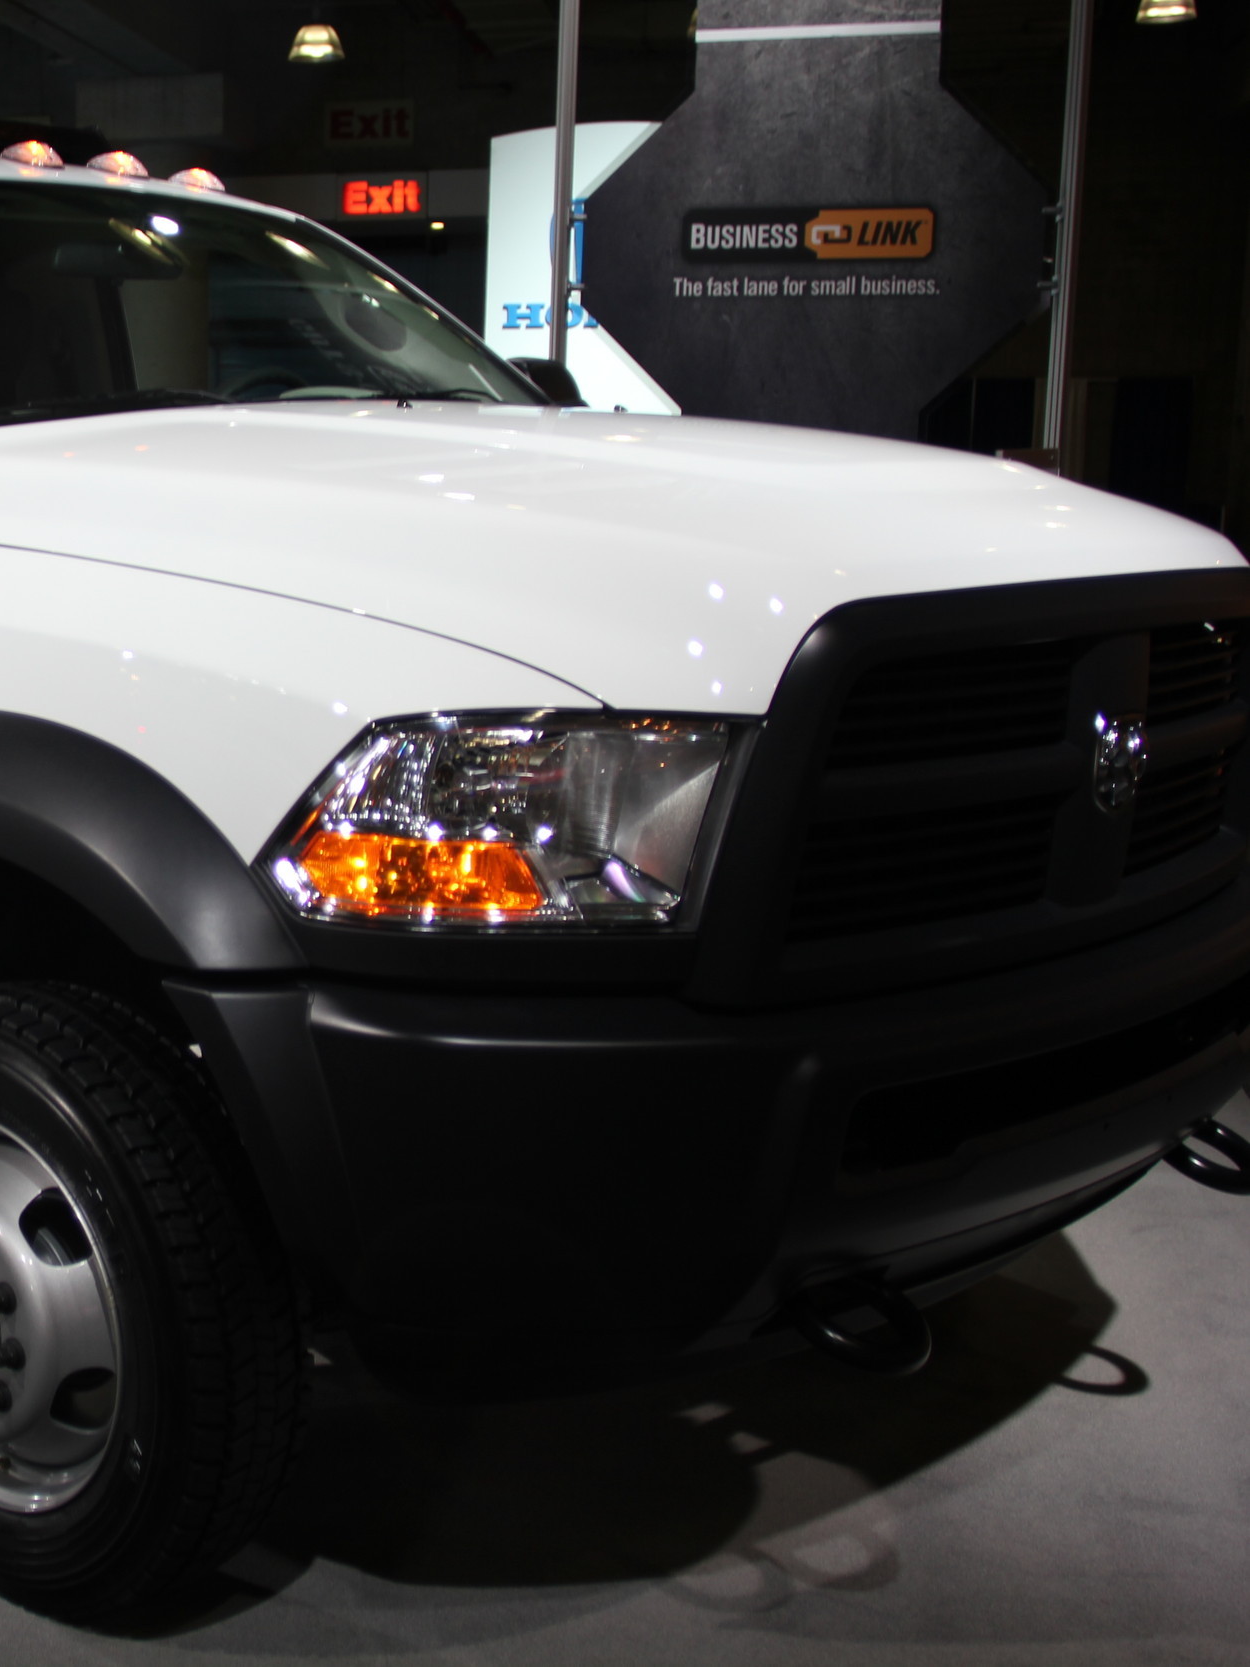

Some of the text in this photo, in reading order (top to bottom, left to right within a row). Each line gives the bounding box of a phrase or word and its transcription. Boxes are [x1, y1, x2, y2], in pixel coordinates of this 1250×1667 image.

[330, 109, 409, 139] Exit
[342, 179, 421, 214] Exit
[691, 219, 922, 249] BUSINESS LINK
[673, 275, 940, 296] The fast lane for small business.
